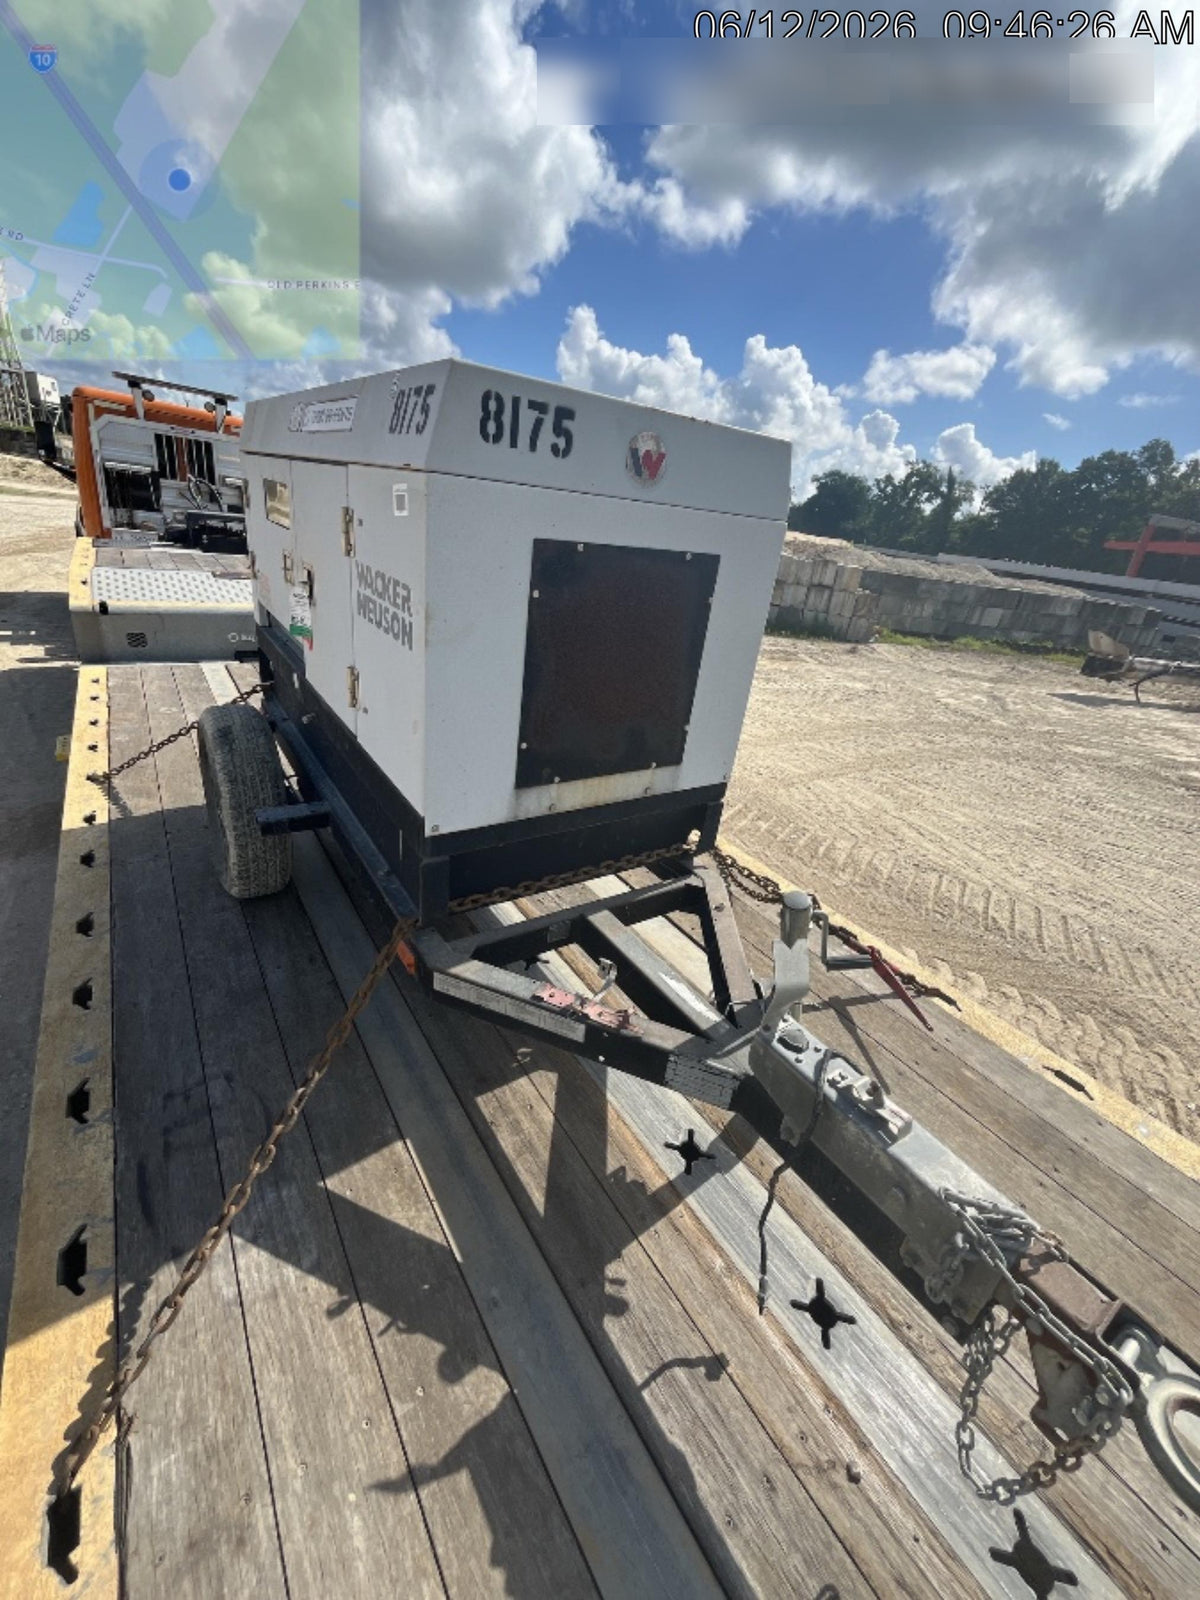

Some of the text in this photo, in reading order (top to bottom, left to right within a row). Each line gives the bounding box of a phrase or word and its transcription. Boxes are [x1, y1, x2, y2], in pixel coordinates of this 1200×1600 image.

[389, 383, 436, 436] 8175
[479, 389, 576, 459] 8175
[355, 559, 413, 618] WACKER
[357, 589, 413, 652] NEUSON
